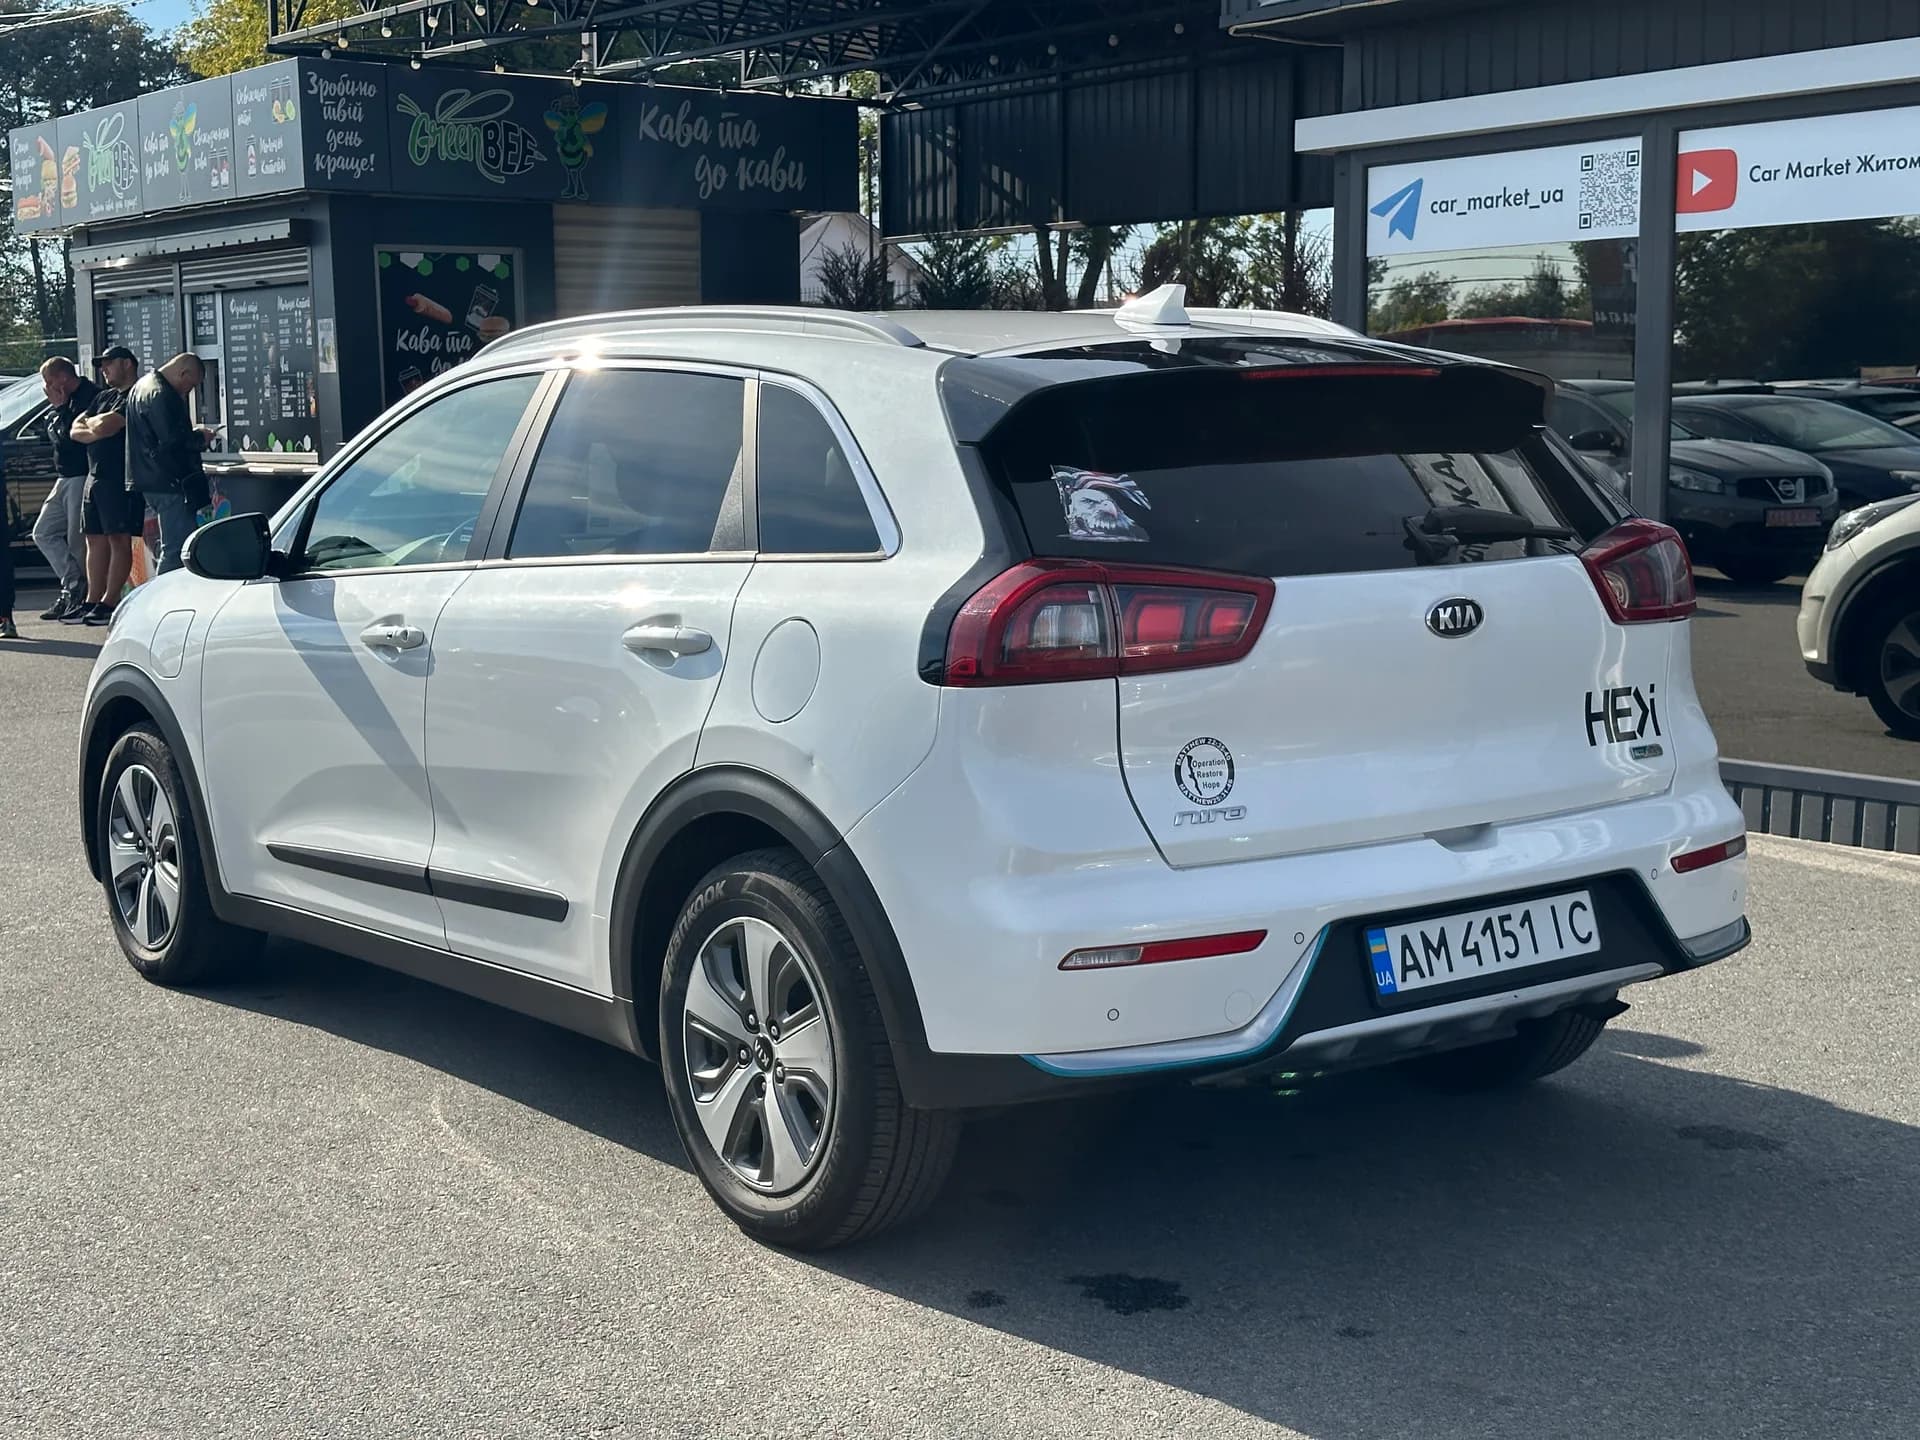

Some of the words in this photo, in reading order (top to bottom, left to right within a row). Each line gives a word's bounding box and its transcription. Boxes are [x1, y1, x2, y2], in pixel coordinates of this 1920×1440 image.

[307, 71, 377, 103] Зробимо
[322, 98, 364, 123] твій
[638, 100, 713, 148] Кава
[717, 111, 761, 149] та
[326, 128, 364, 151] день
[314, 153, 375, 180] краще!
[694, 154, 729, 199] до
[735, 145, 807, 193] кави
[1749, 165, 1781, 183] Car
[1785, 157, 1852, 180] Market
[1856, 154, 1920, 174] Житом
[1430, 186, 1564, 216] car_market_ua
[396, 325, 443, 354] Кава
[445, 331, 473, 353] та
[1437, 605, 1477, 631] KIA
[1192, 759, 1226, 769] Operation
[1196, 770, 1223, 779] Restore
[1202, 781, 1220, 790] Hope
[1401, 926, 1454, 983] AM
[1460, 908, 1540, 967] 4151
[1550, 900, 1593, 950] IC
[1376, 971, 1394, 987] UA
[754, 1039, 770, 1067] KIA
